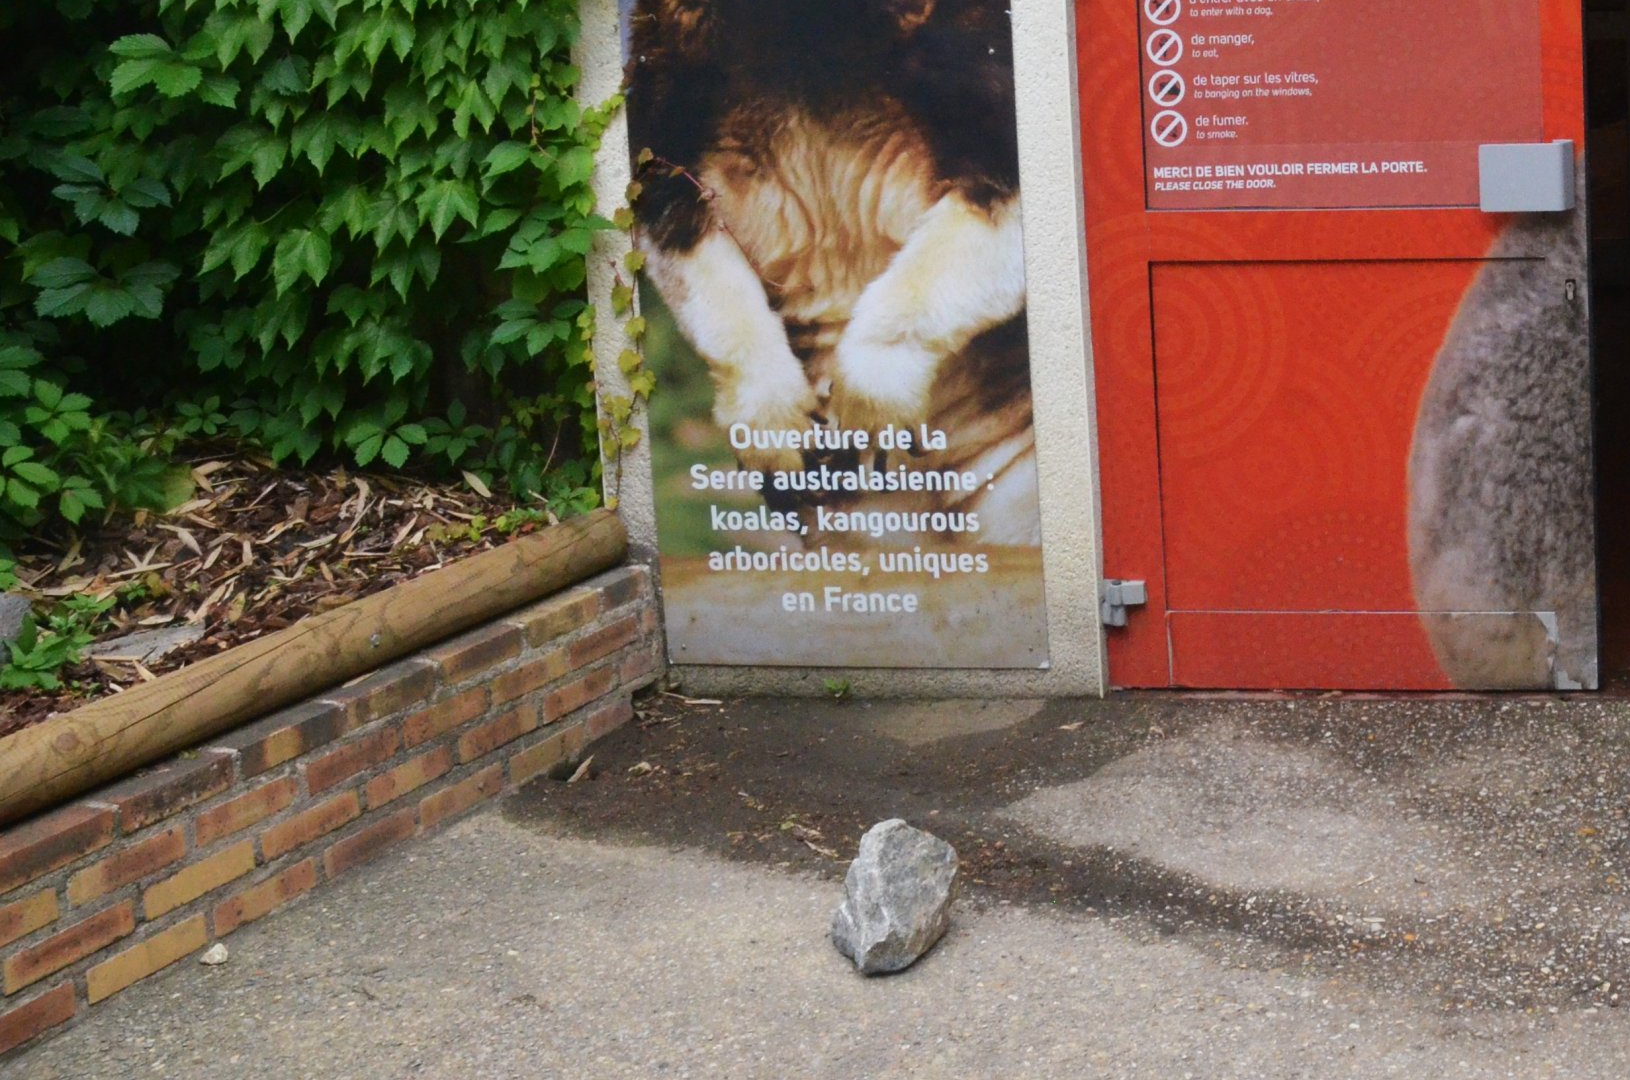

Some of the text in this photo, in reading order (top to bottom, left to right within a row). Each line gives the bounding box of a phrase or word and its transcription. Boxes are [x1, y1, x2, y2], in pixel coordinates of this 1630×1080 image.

[1190, 8, 1199, 17] to
[1201, 8, 1224, 16] enter
[1226, 6, 1244, 16] with
[1191, 34, 1255, 46] de manger,
[1192, 50, 1201, 58] to
[1193, 72, 1319, 88] de taper sur les vitres,
[1194, 90, 1203, 98] to
[1205, 89, 1240, 100] banging
[1256, 88, 1270, 96] the
[1195, 114, 1248, 126] de fumer.
[1196, 130, 1238, 139] to smoke.
[1154, 160, 1428, 178] MERCI DE BIEN VOULOIR FERMER LA PORTE.
[1154, 179, 1276, 192] PLEASE CLOSE THE DOOR.
[728, 422, 947, 451] Ouverture de la
[690, 463, 995, 492] Serre australasienne :
[711, 504, 980, 537] koalas, kangourous
[708, 545, 989, 579] arboricoles, uniques
[781, 585, 919, 613] en France
